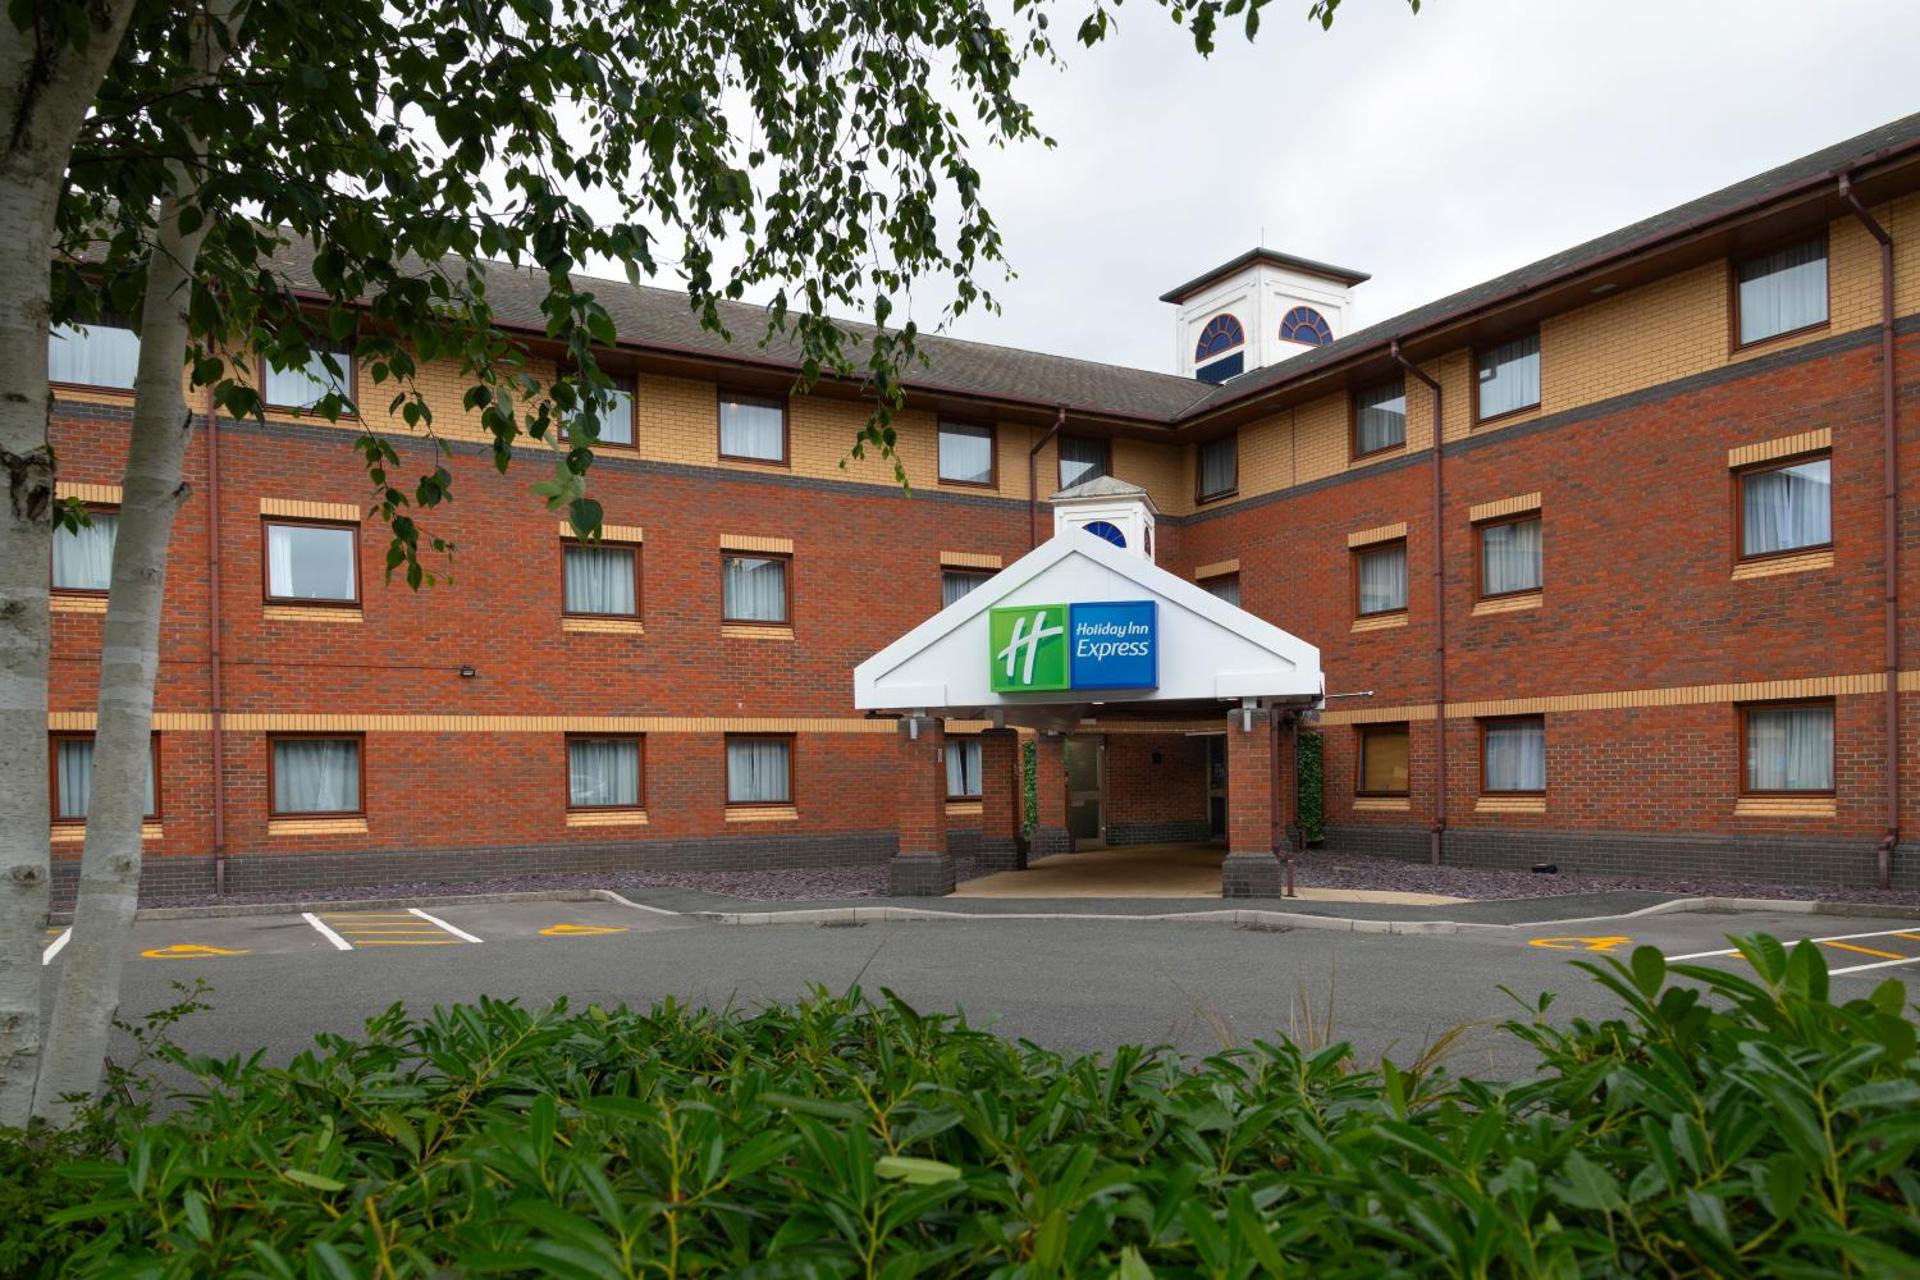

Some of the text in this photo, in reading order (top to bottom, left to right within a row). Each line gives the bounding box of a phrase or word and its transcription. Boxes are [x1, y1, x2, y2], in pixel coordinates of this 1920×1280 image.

[1076, 621, 1149, 638] Holiday Inn
[1076, 638, 1149, 661] Express
